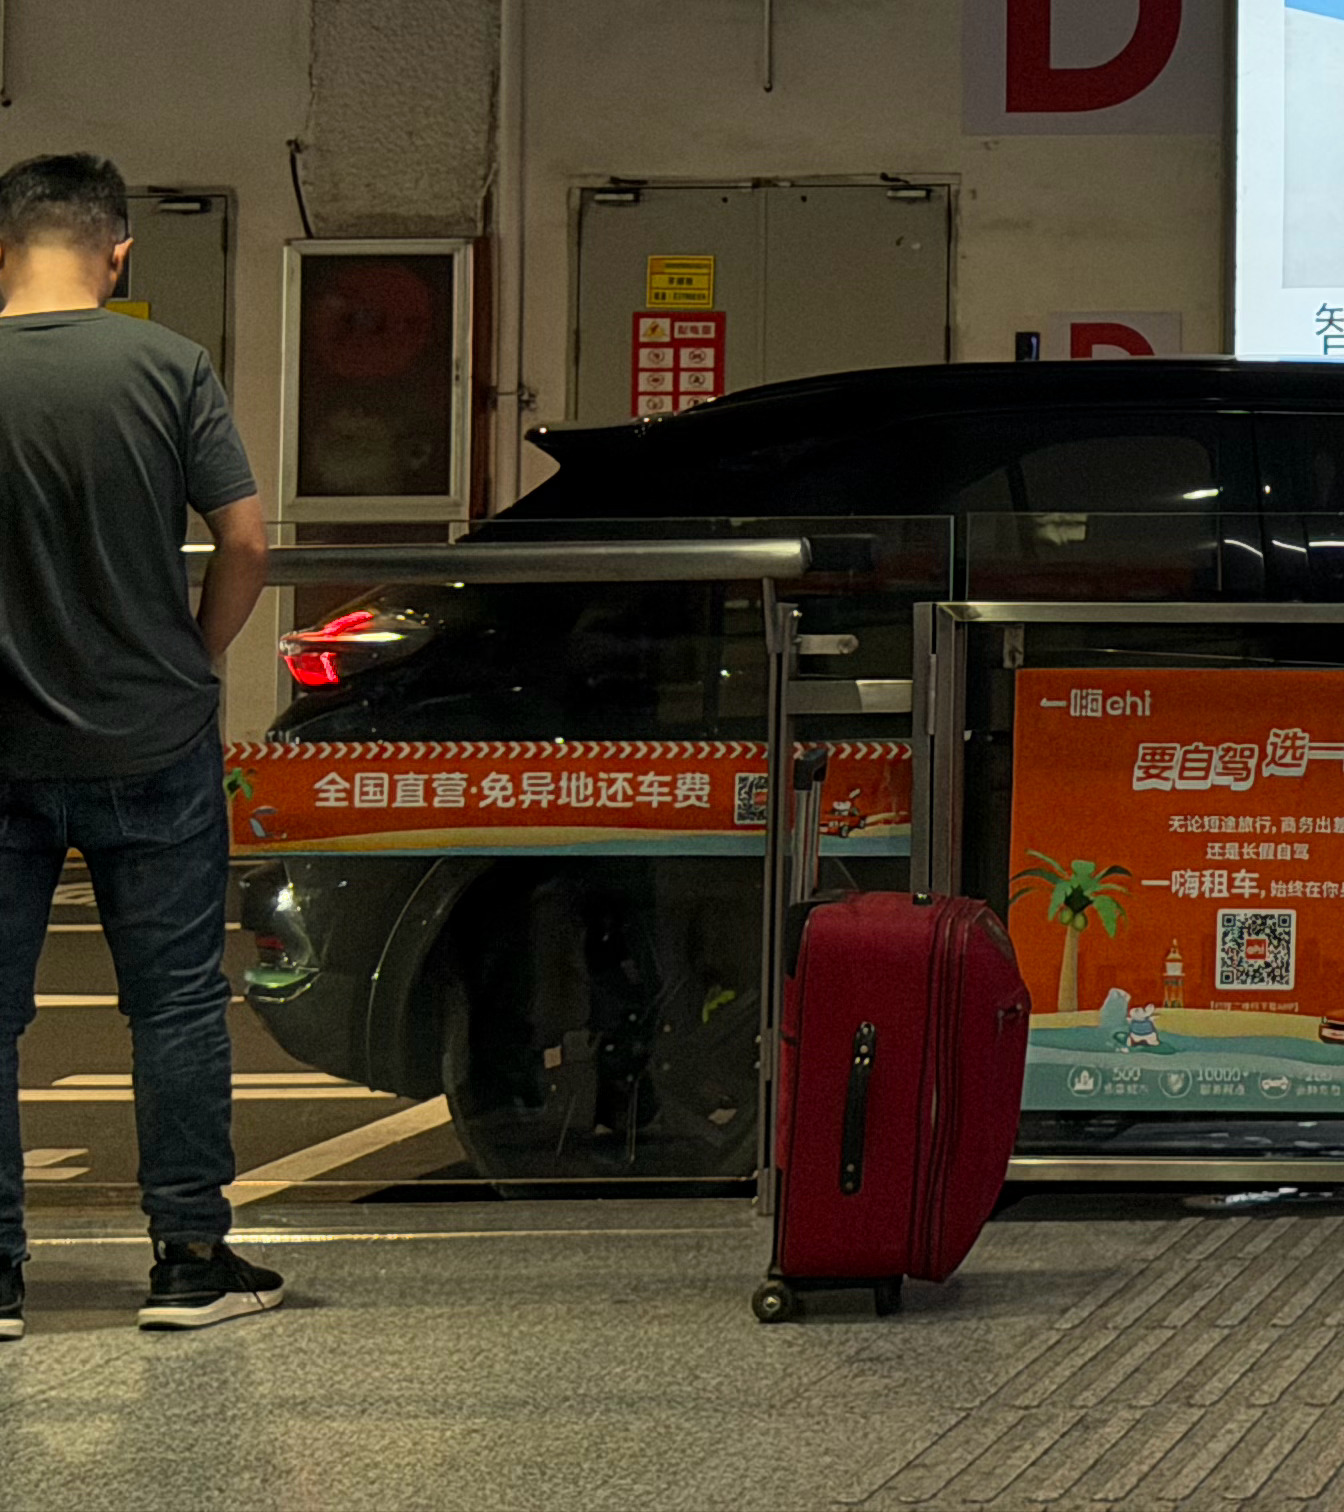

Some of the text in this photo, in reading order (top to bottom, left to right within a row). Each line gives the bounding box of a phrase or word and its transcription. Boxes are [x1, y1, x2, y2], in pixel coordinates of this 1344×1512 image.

[1133, 742, 1258, 791] 要自驾
[314, 771, 711, 810] 全国直营·免异地还车费
[1206, 842, 1310, 860] 还是长假自驾
